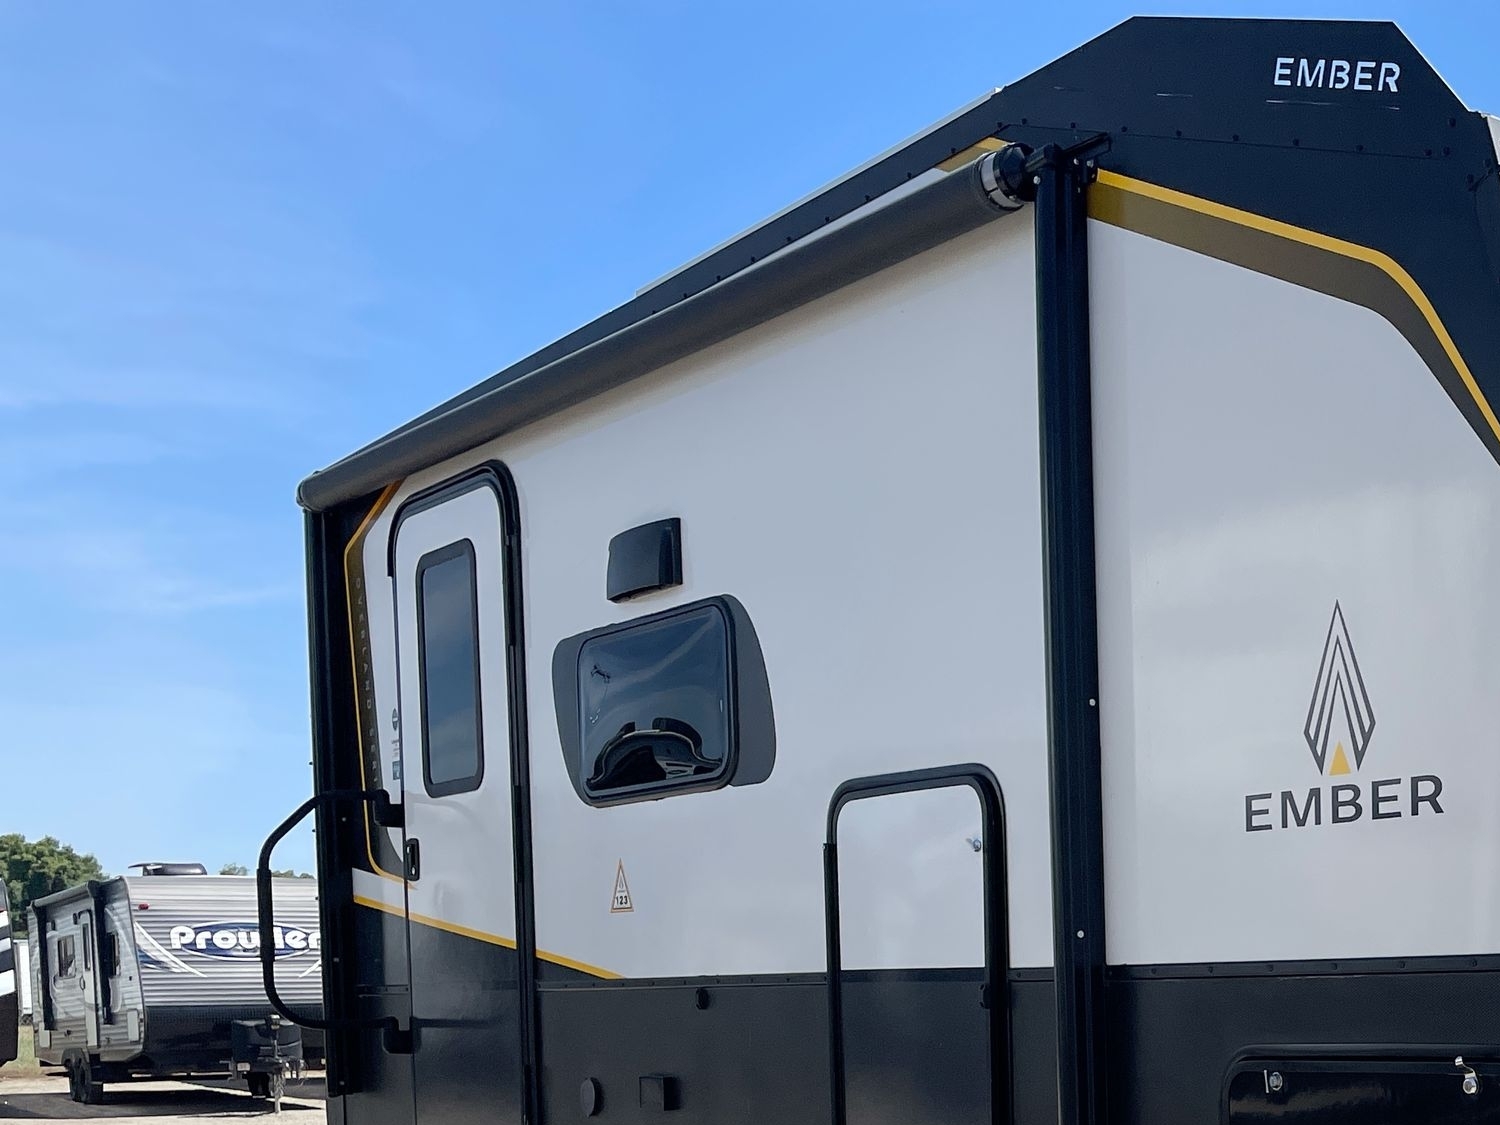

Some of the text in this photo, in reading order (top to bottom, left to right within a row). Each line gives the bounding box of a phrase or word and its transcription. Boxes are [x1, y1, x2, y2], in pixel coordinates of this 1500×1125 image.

[1273, 56, 1401, 93] EMBER
[1244, 774, 1445, 833] EMBER
[616, 895, 628, 905] 123
